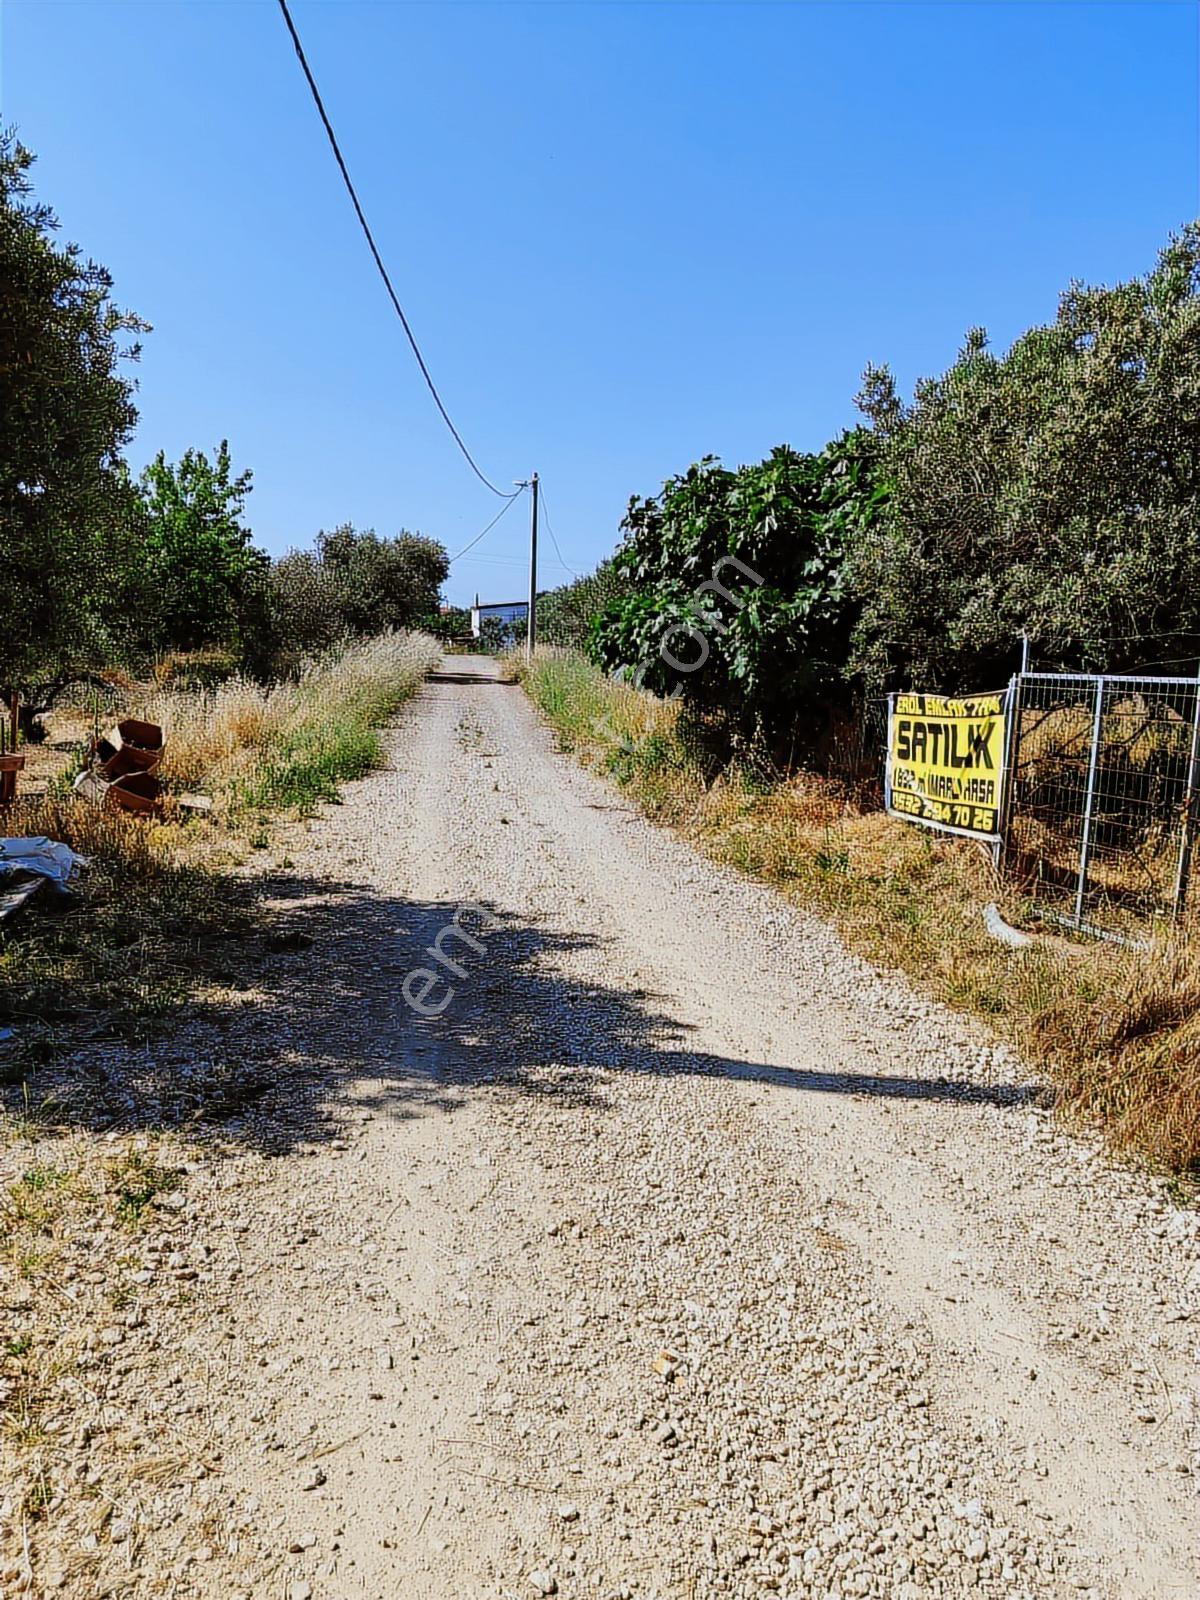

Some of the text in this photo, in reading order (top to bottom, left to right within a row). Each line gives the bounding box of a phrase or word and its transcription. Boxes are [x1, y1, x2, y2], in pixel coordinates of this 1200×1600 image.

[897, 720, 996, 769] SATILIK
[964, 777, 995, 805] ARSA
[953, 806, 971, 827] 70
